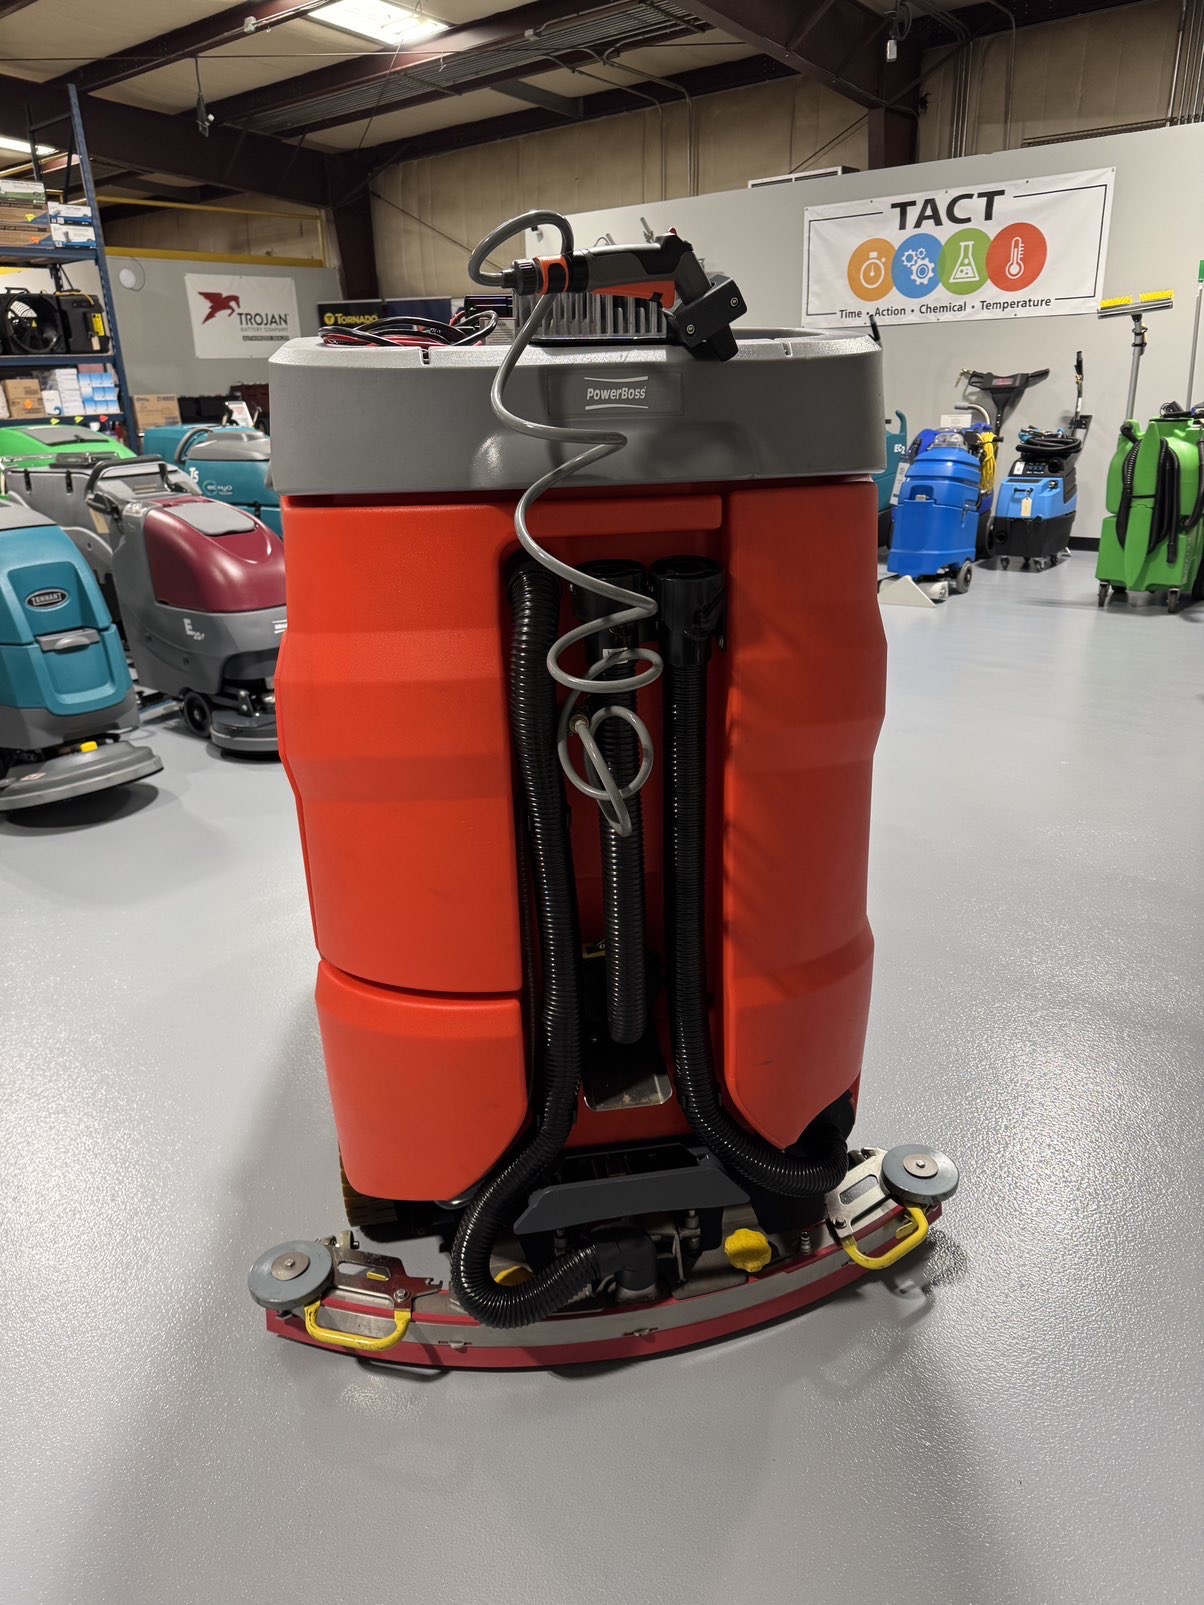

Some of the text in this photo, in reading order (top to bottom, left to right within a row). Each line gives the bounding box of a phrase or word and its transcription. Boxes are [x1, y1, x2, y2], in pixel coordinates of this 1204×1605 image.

[891, 189, 1005, 231] TACT
[839, 296, 1051, 319] Time Action Chemical Temperature
[237, 312, 288, 326] TROJAN
[335, 313, 379, 325] TORNADO
[586, 386, 647, 400] PowerBoss
